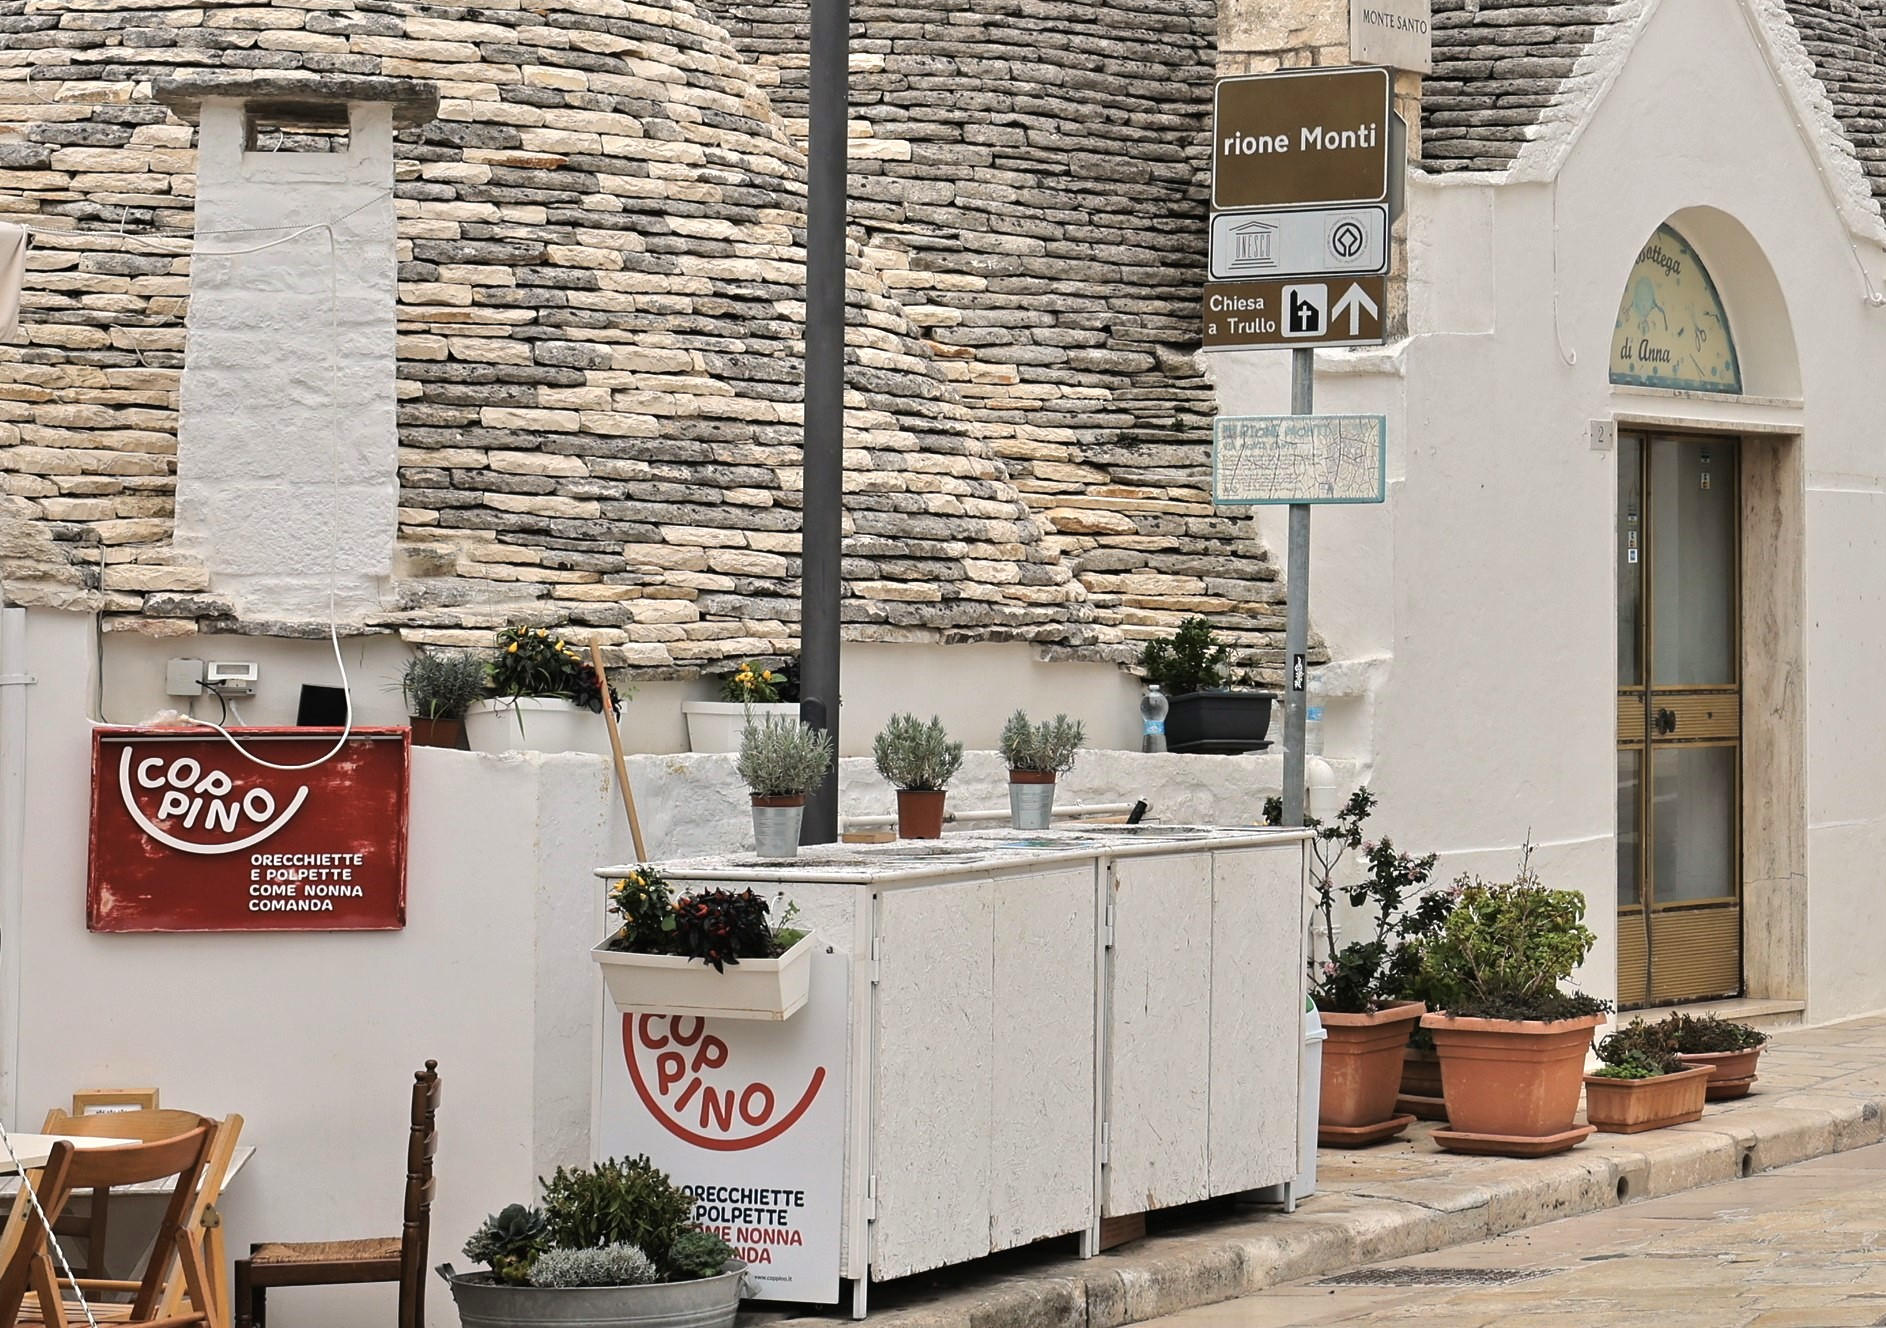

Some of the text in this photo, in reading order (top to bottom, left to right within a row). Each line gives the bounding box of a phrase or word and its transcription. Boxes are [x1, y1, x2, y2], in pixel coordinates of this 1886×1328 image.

[1363, 9, 1428, 33] MONTE SANTO
[1224, 123, 1377, 156] rione Monti
[1235, 234, 1271, 258] UNESCO
[1209, 294, 1264, 312] Chiesa
[1208, 318, 1276, 335] a Trullo
[1620, 335, 1671, 363] di Anna
[1597, 427, 1605, 443] 2
[137, 757, 233, 797] COP
[157, 787, 276, 834] PINO
[250, 853, 364, 867] ORECCHIETTE
[250, 869, 352, 882] E POLPETTE
[249, 884, 364, 898] COME NONNA
[248, 899, 334, 912] COMANDA
[638, 1011, 729, 1074] COP
[656, 1051, 775, 1133] PINO
[681, 1185, 805, 1207] ORECCHIETTE
[695, 1205, 788, 1226] POLPETTE
[736, 1226, 803, 1247] NONNA
